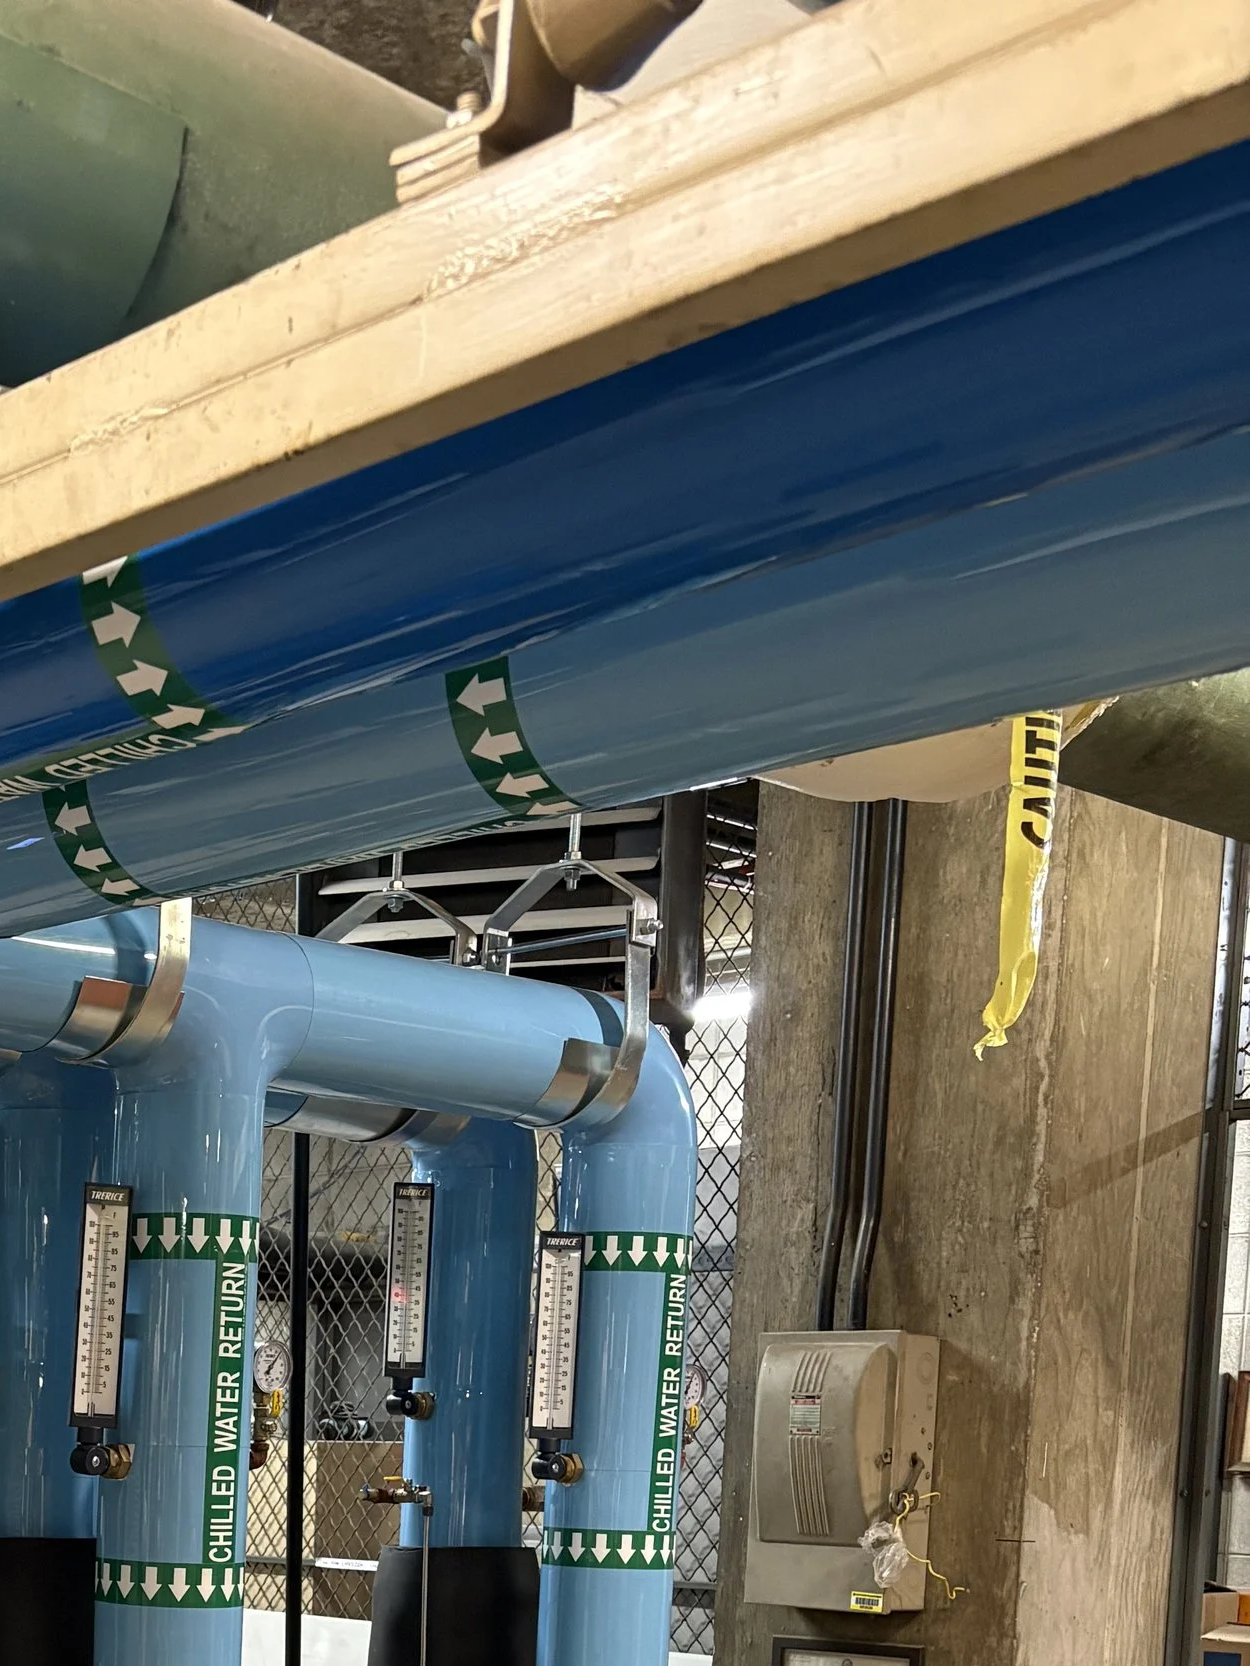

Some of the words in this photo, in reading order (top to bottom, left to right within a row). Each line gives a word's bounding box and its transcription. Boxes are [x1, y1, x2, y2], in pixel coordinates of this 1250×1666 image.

[43, 733, 196, 780] CHILLED
[1020, 708, 1060, 849] CAUTI
[91, 1190, 125, 1202] TRERICE
[546, 1237, 578, 1246] TRERICE
[217, 1261, 246, 1359] RETURN
[664, 1273, 687, 1357] RETURN
[213, 1371, 241, 1452] WATER
[659, 1367, 681, 1438] WATER
[208, 1464, 236, 1564] CHILLED
[652, 1447, 675, 1533] CHILLED
